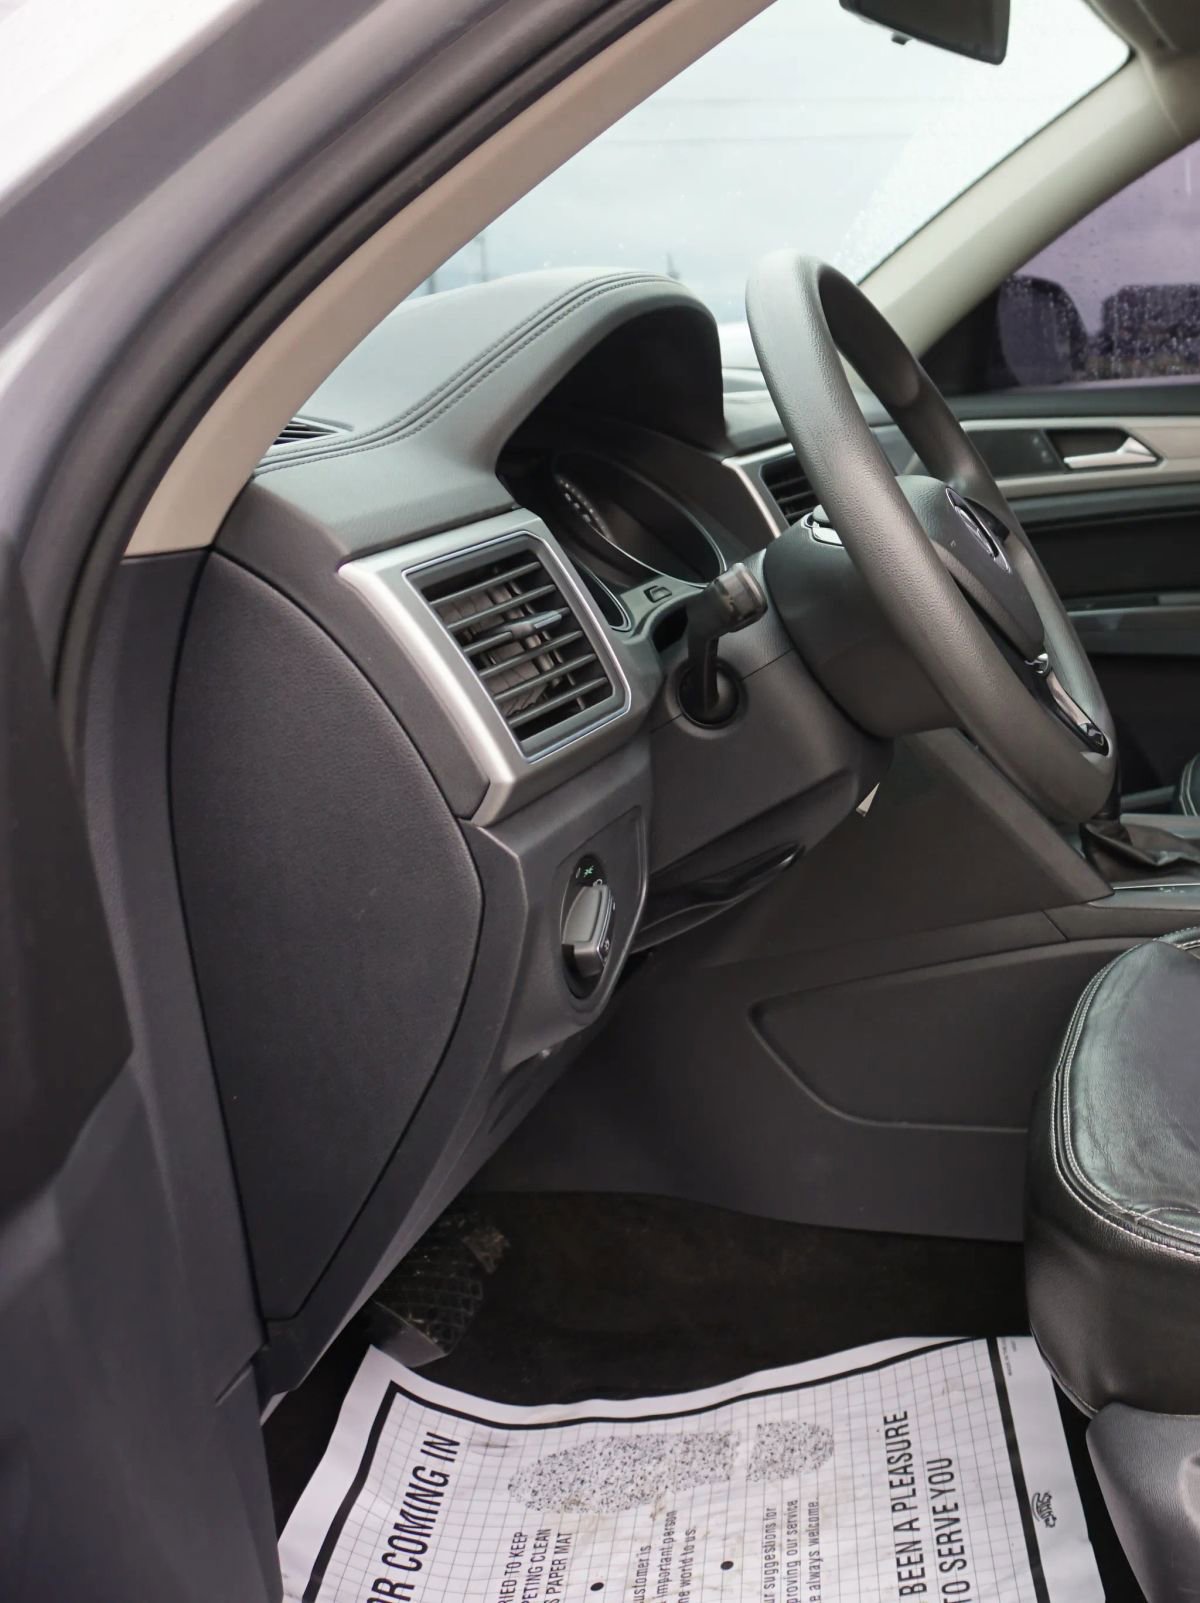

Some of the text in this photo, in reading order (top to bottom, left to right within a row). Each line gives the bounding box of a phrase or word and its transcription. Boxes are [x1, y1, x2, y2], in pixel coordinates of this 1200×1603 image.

[926, 1458, 956, 1499] YOU
[381, 1465, 450, 1572] COMING
[420, 1431, 460, 1462] IN
[763, 1508, 777, 1521] for
[784, 1500, 798, 1535] service
[883, 1411, 927, 1596] BEEN A PLEASURE
[508, 1531, 528, 1558] KEEP
[554, 1532, 572, 1554] MAT
[663, 1510, 677, 1544] person
[932, 1502, 967, 1573] SERVE
[530, 1528, 552, 1563] CLEAN
[680, 1545, 695, 1556] to
[762, 1522, 779, 1589] suggestions
[786, 1539, 798, 1556] our
[504, 1561, 522, 1576] TO
[546, 1558, 568, 1594] PAPER
[632, 1545, 651, 1603] ustomer is
[656, 1545, 673, 1599] important
[678, 1558, 694, 1588] world
[806, 1550, 824, 1591] always
